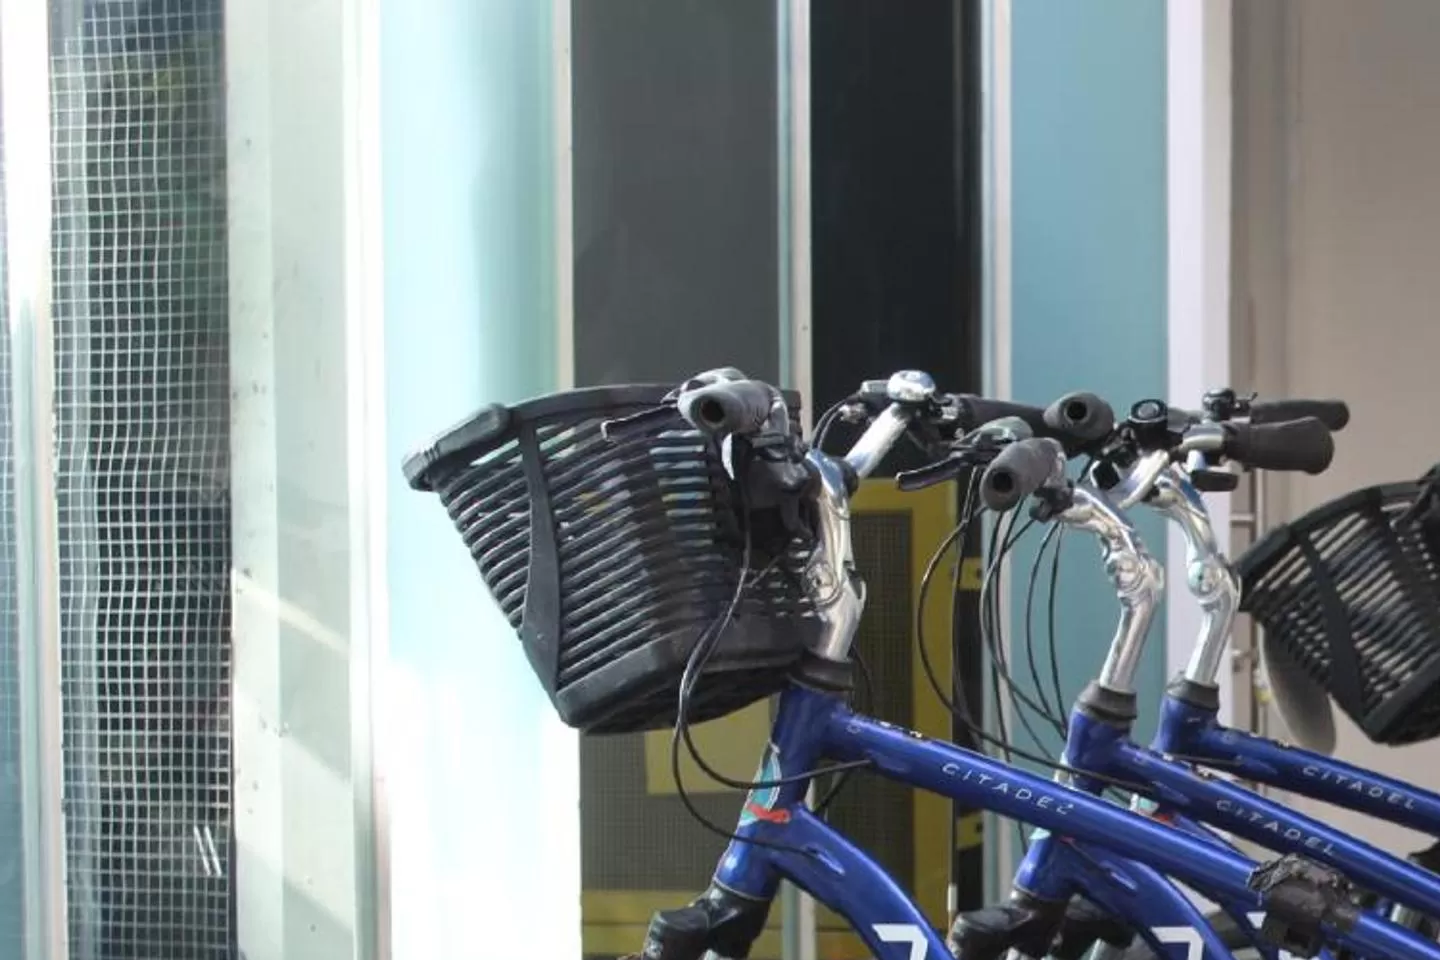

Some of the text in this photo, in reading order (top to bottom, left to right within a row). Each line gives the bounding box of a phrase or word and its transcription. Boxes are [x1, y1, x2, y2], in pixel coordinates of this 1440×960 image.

[942, 762, 1075, 816] CITADEL
[1302, 766, 1415, 810] CITADEL
[1216, 799, 1334, 857] CITADEL
